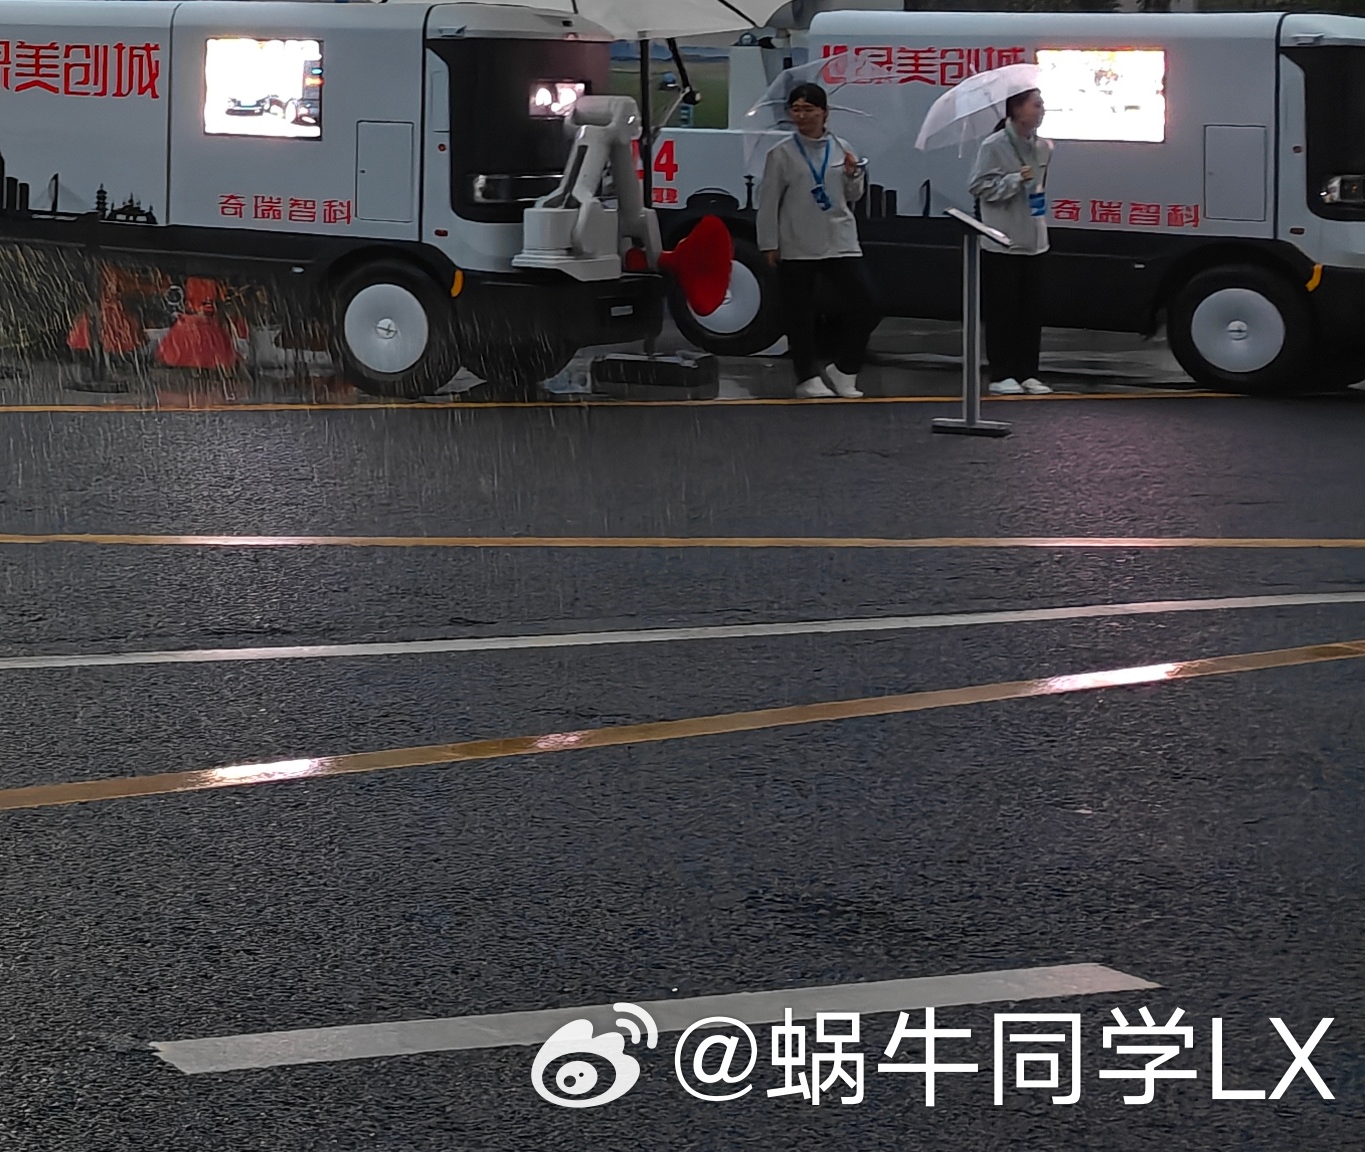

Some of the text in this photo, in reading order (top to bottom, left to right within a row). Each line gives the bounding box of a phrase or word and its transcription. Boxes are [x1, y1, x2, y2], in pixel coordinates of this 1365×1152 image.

[217, 193, 352, 226] 奇瑞智科
[1050, 199, 1201, 229] 奇瑞智科
